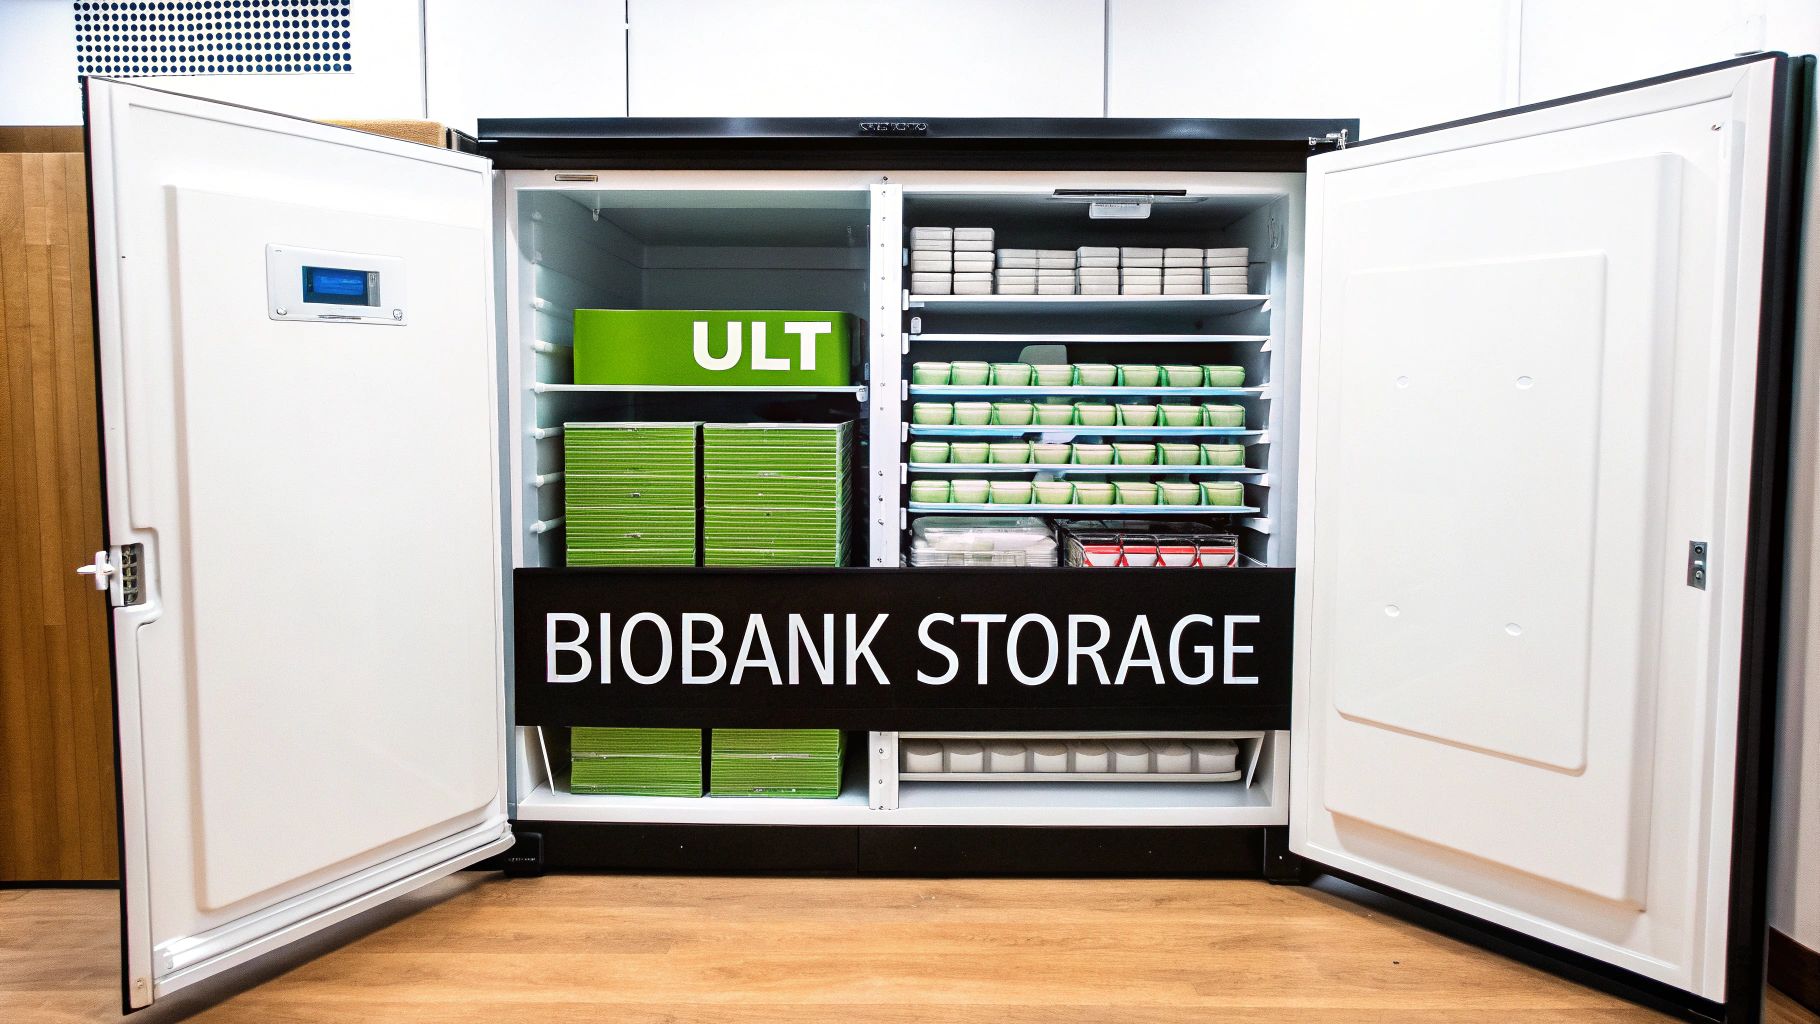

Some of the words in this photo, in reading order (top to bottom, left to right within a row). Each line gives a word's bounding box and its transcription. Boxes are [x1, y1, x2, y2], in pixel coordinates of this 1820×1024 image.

[693, 320, 832, 371] ULT
[546, 611, 891, 686] BIOBANK
[917, 612, 1261, 686] STORAGE
